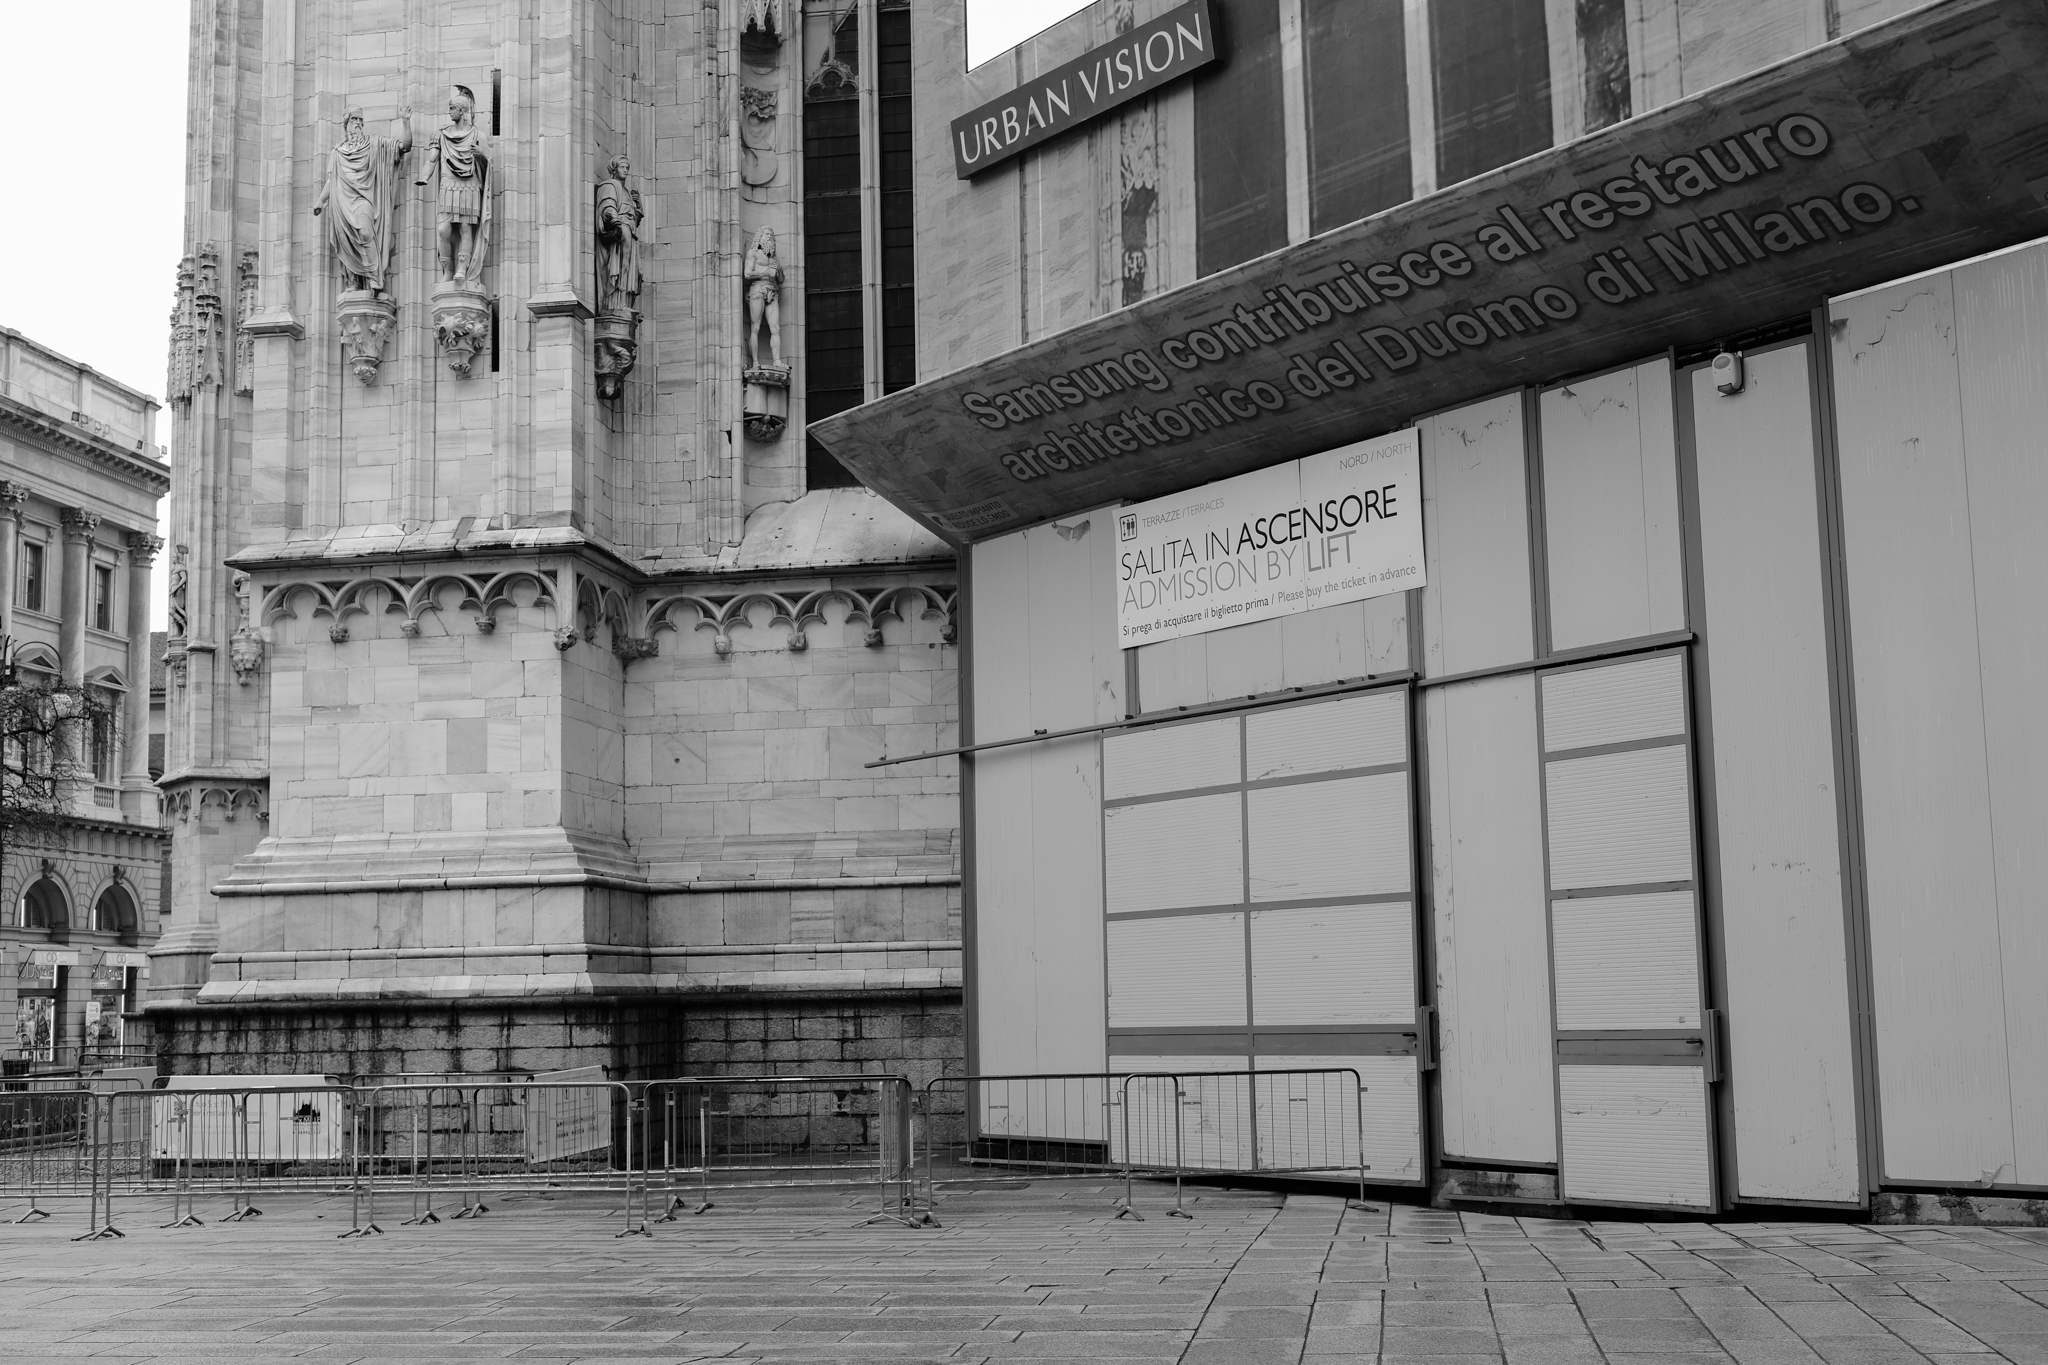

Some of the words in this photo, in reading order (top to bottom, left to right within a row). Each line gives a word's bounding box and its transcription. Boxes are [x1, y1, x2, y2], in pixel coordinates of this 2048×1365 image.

[960, 80, 1070, 163] URBAN
[1079, 13, 1203, 103] VISION
[962, 346, 1167, 430] Samsung
[1160, 234, 1474, 371] contribuisce
[1479, 205, 1541, 263] al
[1542, 112, 1831, 238] restauro
[1000, 377, 1287, 484] architettonico
[1287, 341, 1370, 400] del
[1358, 283, 1577, 372] Duomo
[1587, 247, 1655, 305] di
[1645, 181, 1920, 283] Milano.
[1340, 454, 1368, 469] NORD
[1377, 442, 1411, 460] NORTH
[943, 510, 969, 521] QUESTO
[967, 501, 1001, 516] IMPIANTO
[952, 519, 979, 529] RIDUCE
[977, 516, 989, 525] LO
[987, 509, 1010, 522] SMOG
[1122, 538, 1197, 580] SALITA
[1206, 528, 1229, 561] IN
[1237, 484, 1397, 554] ASCENSORE
[1142, 510, 1180, 527] TERRAZZE
[1188, 498, 1224, 516] TERRACES
[1123, 555, 1256, 613] ADMISSION
[1267, 545, 1297, 580] BY
[1307, 530, 1356, 572] LIFT
[1123, 626, 1129, 635] Si
[1132, 624, 1152, 636] prega
[1155, 619, 1161, 629] di
[1164, 613, 1201, 628] acquistare
[1205, 608, 1208, 618] il
[1211, 604, 1242, 619] biglietto
[1246, 599, 1269, 613] prima
[1278, 591, 1304, 603] Please
[1307, 587, 1321, 598] buy
[1325, 582, 1338, 593] the
[1342, 576, 1366, 589] ticket
[1369, 573, 1377, 583] in
[1380, 566, 1416, 581] advance
